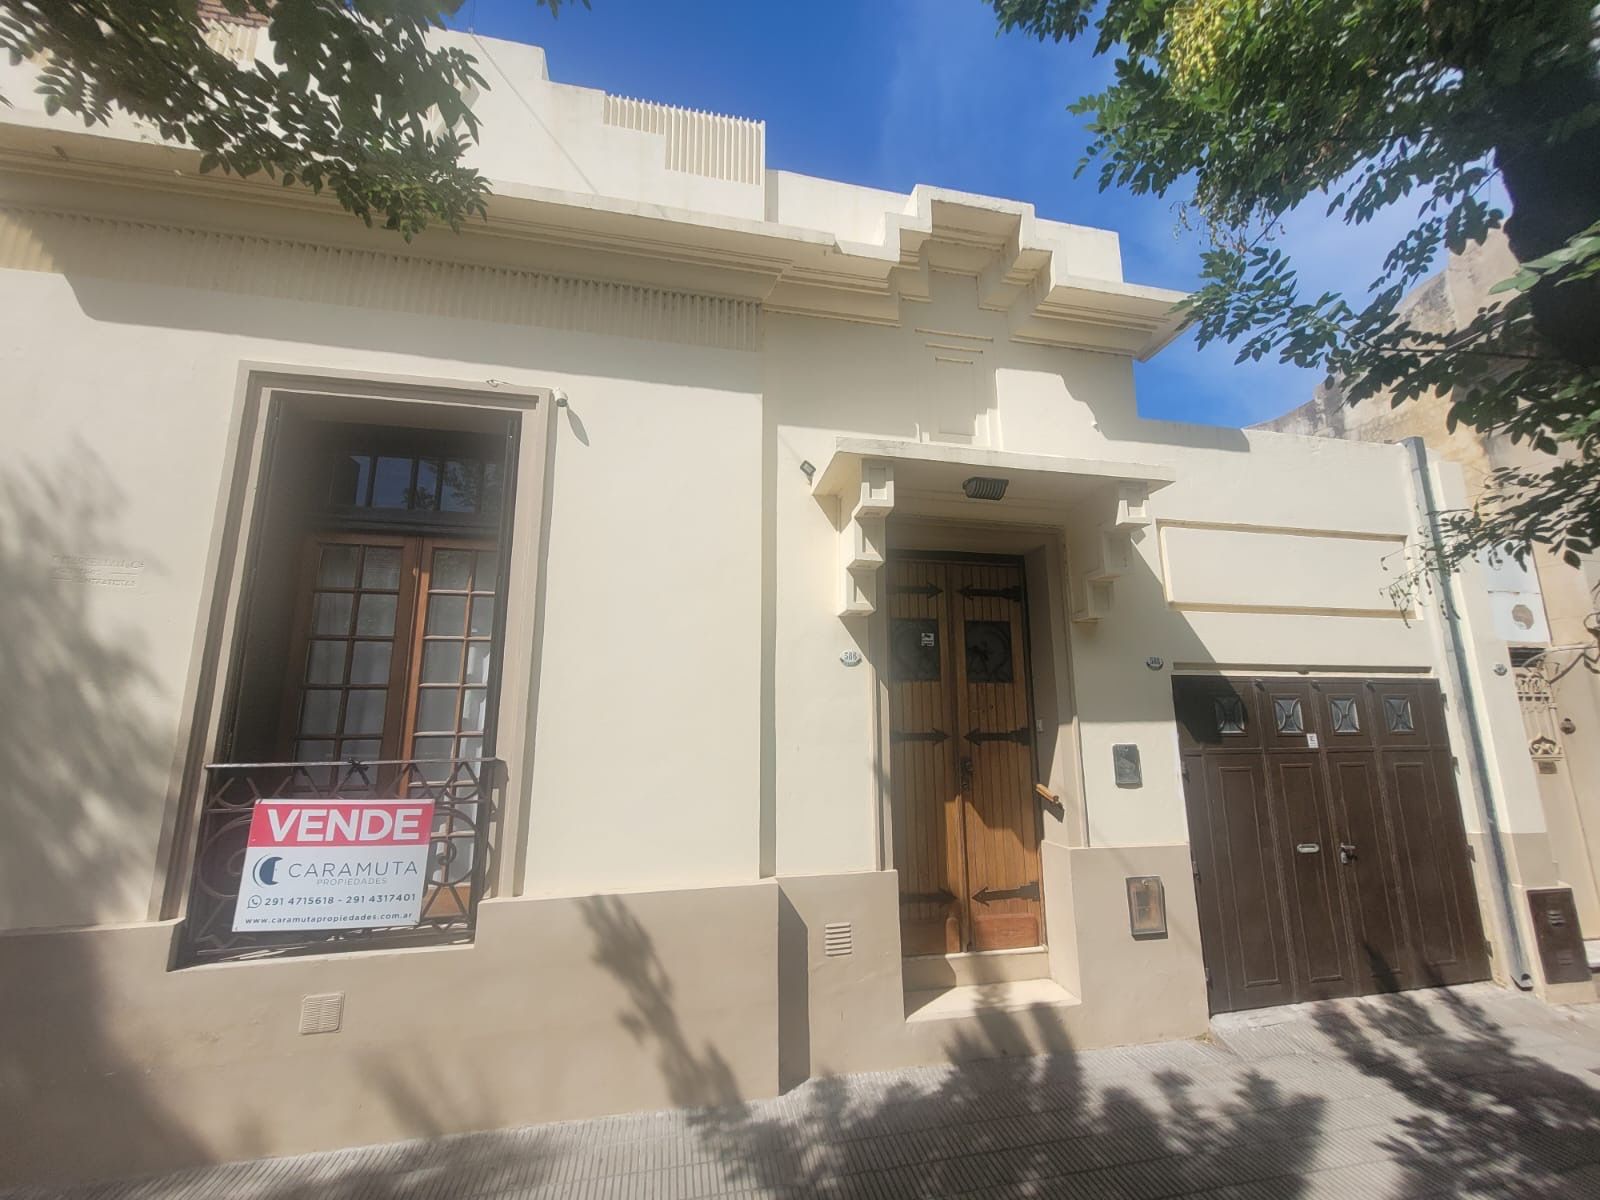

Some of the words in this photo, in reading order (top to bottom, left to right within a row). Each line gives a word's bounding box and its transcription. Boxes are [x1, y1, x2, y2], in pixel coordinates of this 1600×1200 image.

[267, 808, 423, 842] VENDE
[288, 861, 418, 878] CARAMUTA
[316, 877, 388, 886] PROPIEDADES
[264, 897, 284, 906] 291
[288, 896, 334, 905] 4715618
[345, 895, 365, 904] 291
[368, 893, 416, 903] 4317401
[245, 912, 413, 924] www.caramutapropiedades.com.ar
